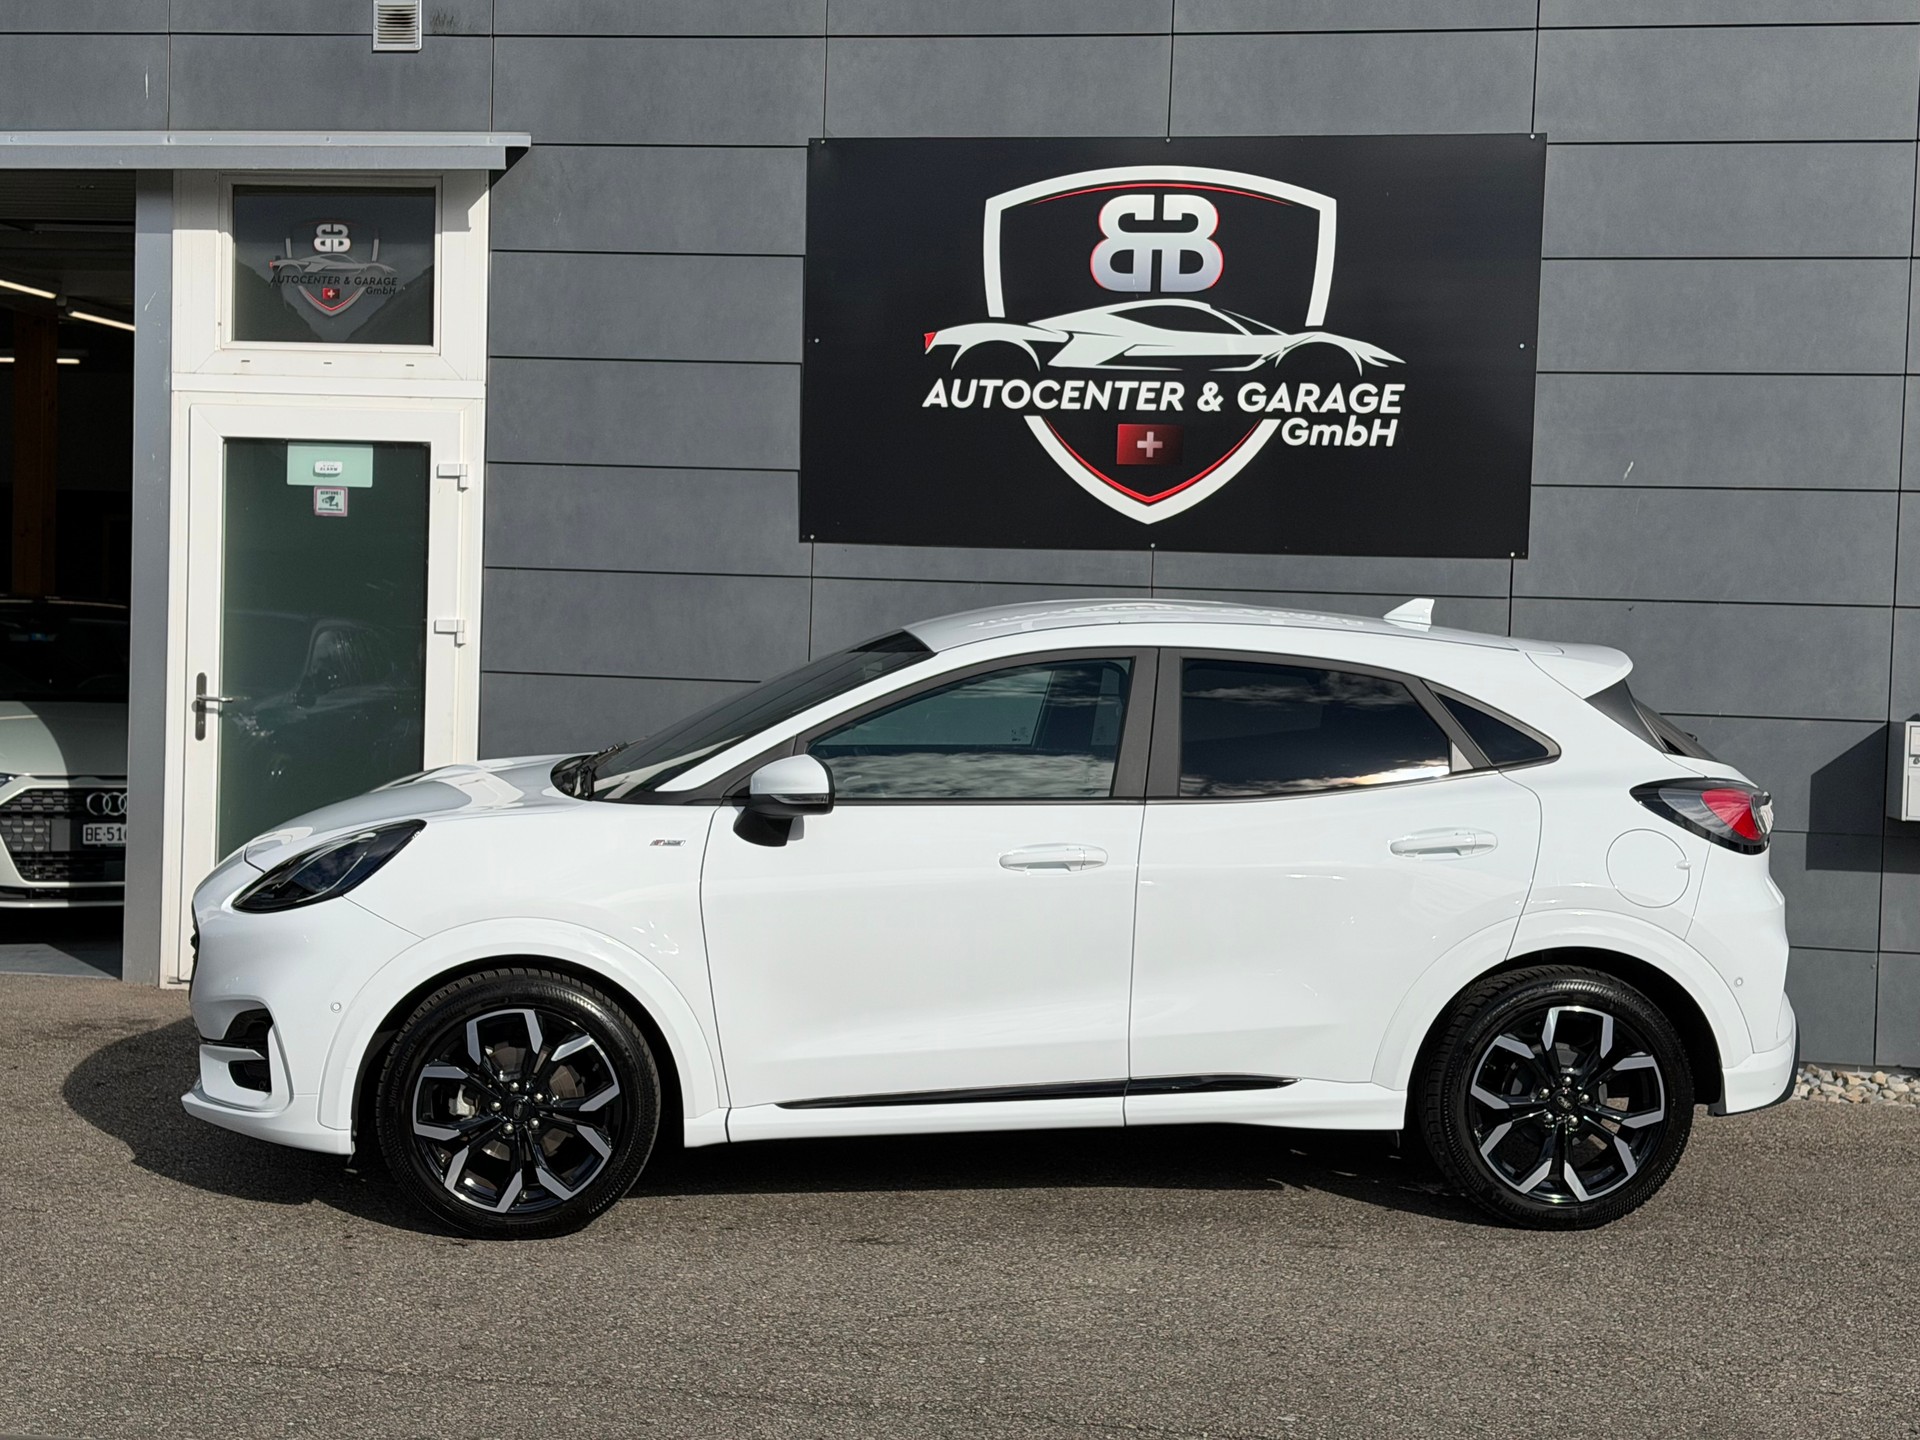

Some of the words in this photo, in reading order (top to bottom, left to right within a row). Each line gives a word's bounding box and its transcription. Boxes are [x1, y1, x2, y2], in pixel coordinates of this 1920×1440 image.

[270, 275, 340, 285] AUTOCENTER
[343, 276, 350, 285] &
[354, 276, 398, 287] GARAGE
[366, 287, 397, 295] GmbH
[921, 377, 1185, 412] AUTOCENTER
[1196, 381, 1224, 412] &
[1237, 381, 1406, 414] GARAGE
[1281, 414, 1399, 447] GmbH
